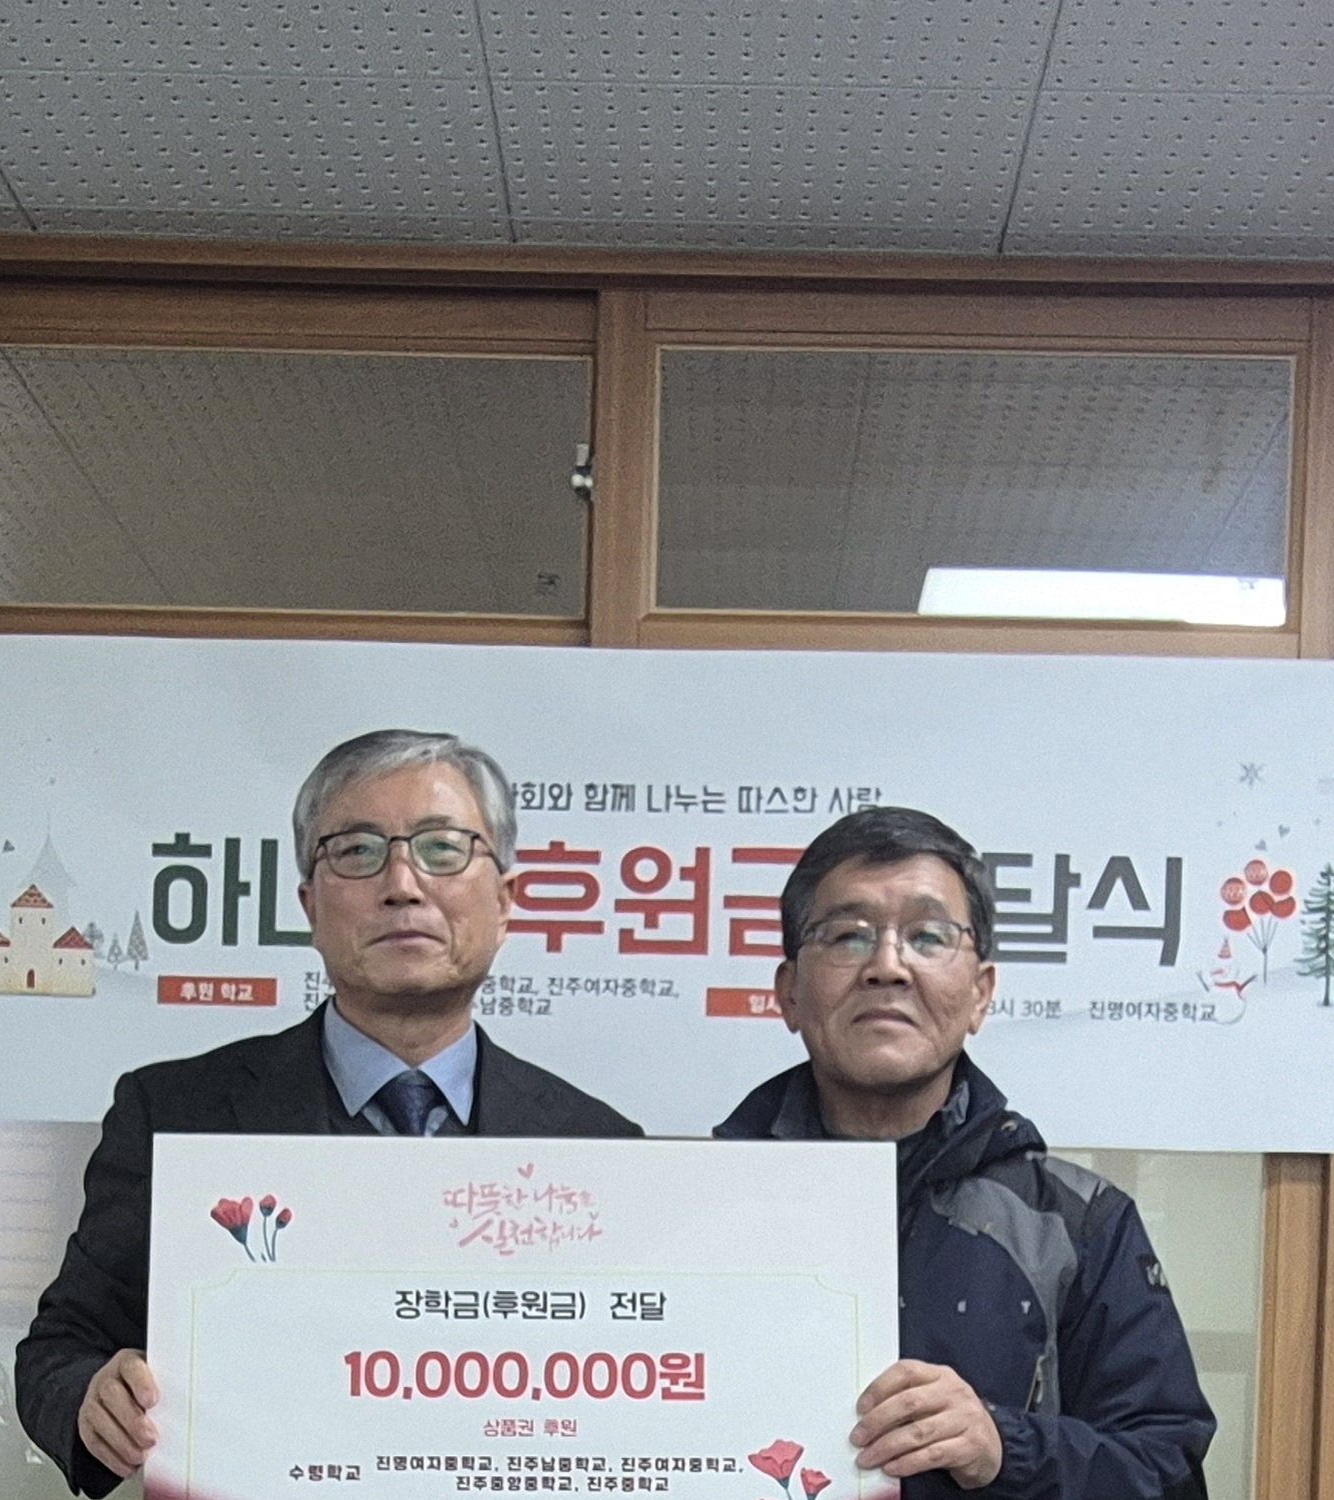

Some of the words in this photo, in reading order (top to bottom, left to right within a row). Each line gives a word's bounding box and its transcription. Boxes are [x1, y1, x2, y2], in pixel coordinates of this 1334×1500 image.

[584, 783, 636, 812] 함께
[647, 784, 727, 814] 나누는
[737, 785, 819, 814] 따스한
[180, 982, 214, 1000] 후원
[221, 983, 254, 1001] 학교
[547, 976, 680, 998] 진주여자중학교,
[1022, 1001, 1061, 1019] 30분
[1089, 1001, 1217, 1022] 진명여자중학교
[394, 1289, 587, 1320] 장학금(후원금)
[610, 1291, 667, 1321] 전달
[344, 1351, 706, 1401] 10,000,000원
[483, 1419, 534, 1437] 상품권
[544, 1419, 578, 1437] 후원
[289, 1464, 361, 1482] 수령학교
[376, 1455, 499, 1472] 진명여자중학교,
[507, 1456, 613, 1473] 진주남중학교,
[621, 1457, 744, 1473] 진주여자중학교,
[587, 1477, 669, 1492] 진주중학교
